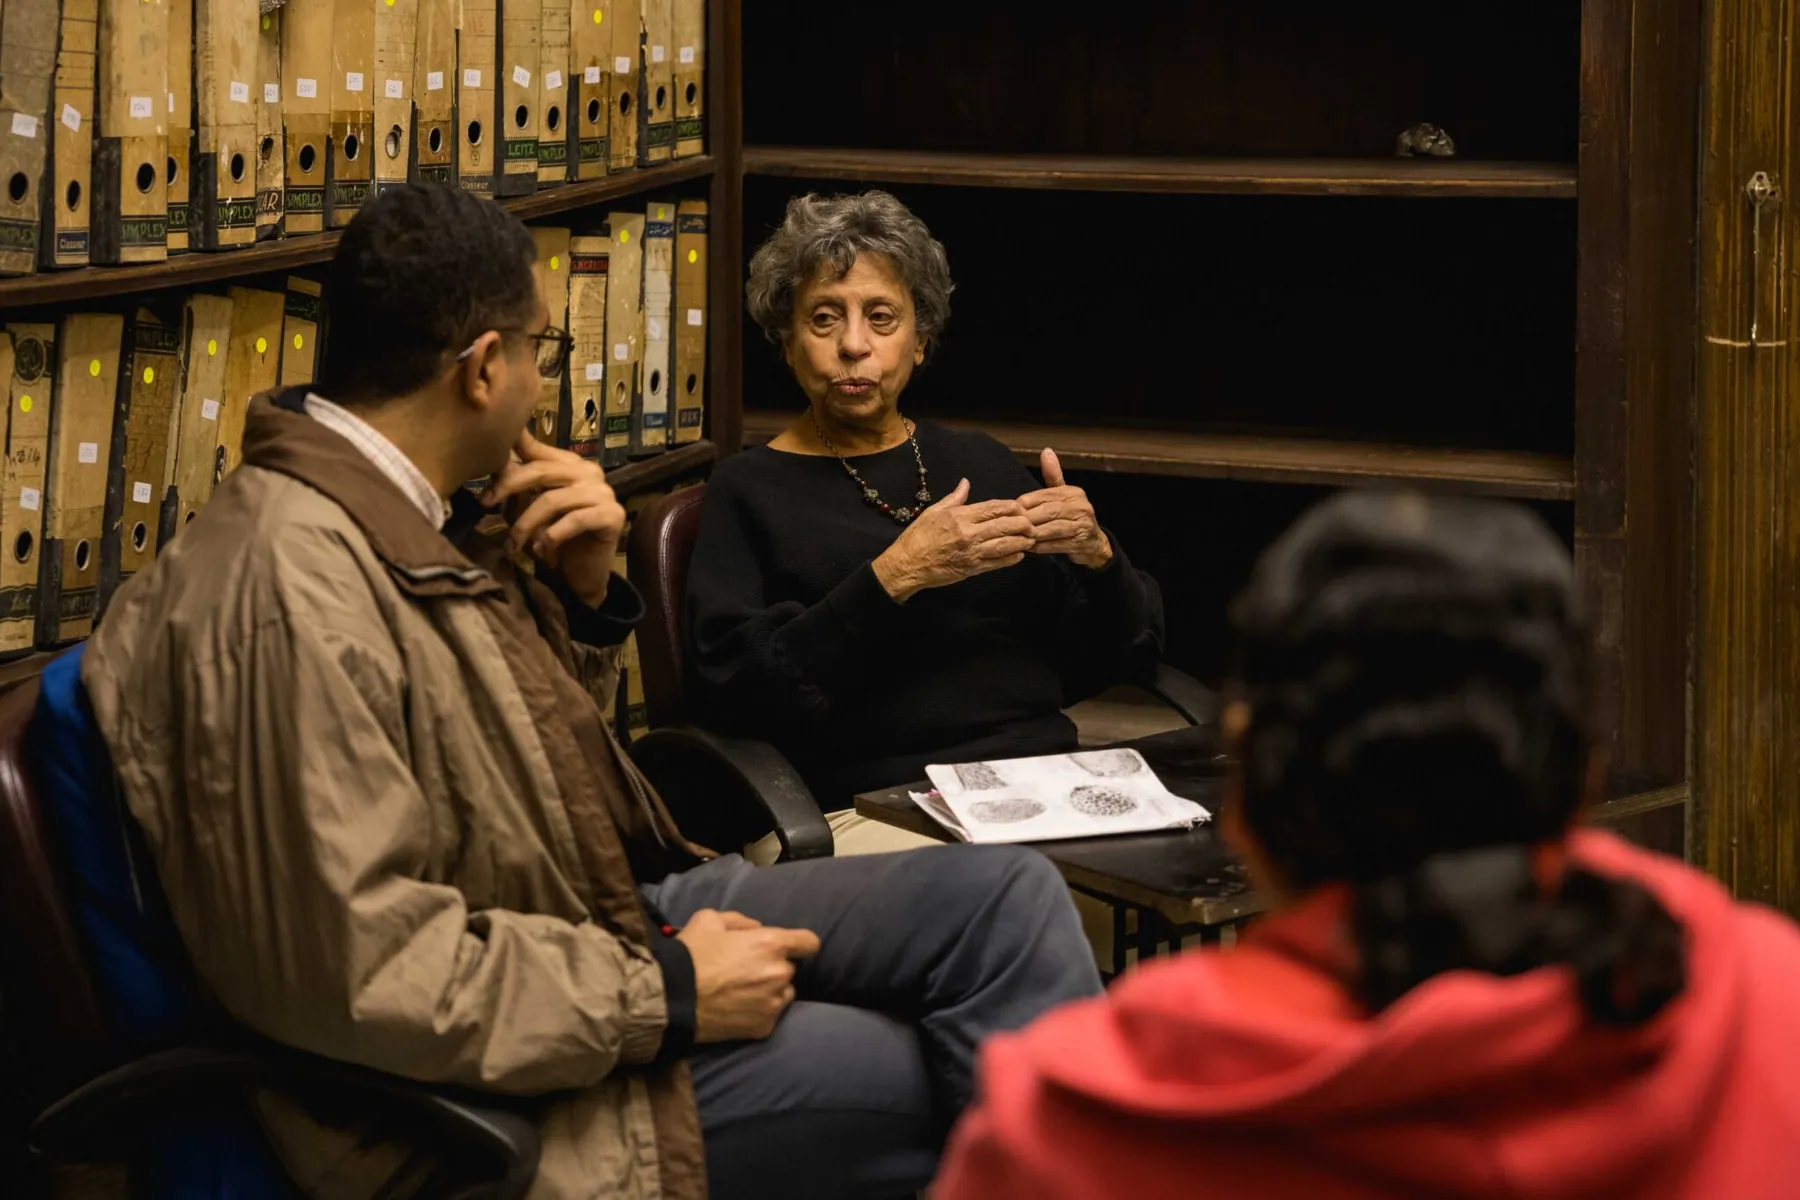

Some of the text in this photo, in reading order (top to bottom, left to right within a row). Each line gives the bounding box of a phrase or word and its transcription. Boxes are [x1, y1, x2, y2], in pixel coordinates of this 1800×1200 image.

[508, 143, 535, 156] LEITZ
[461, 180, 489, 190] Classeur
[286, 191, 323, 208] SIMPLEX
[170, 209, 187, 224] LEX
[217, 205, 255, 221] SIMPLEX
[122, 221, 166, 240] SIMPLEX
